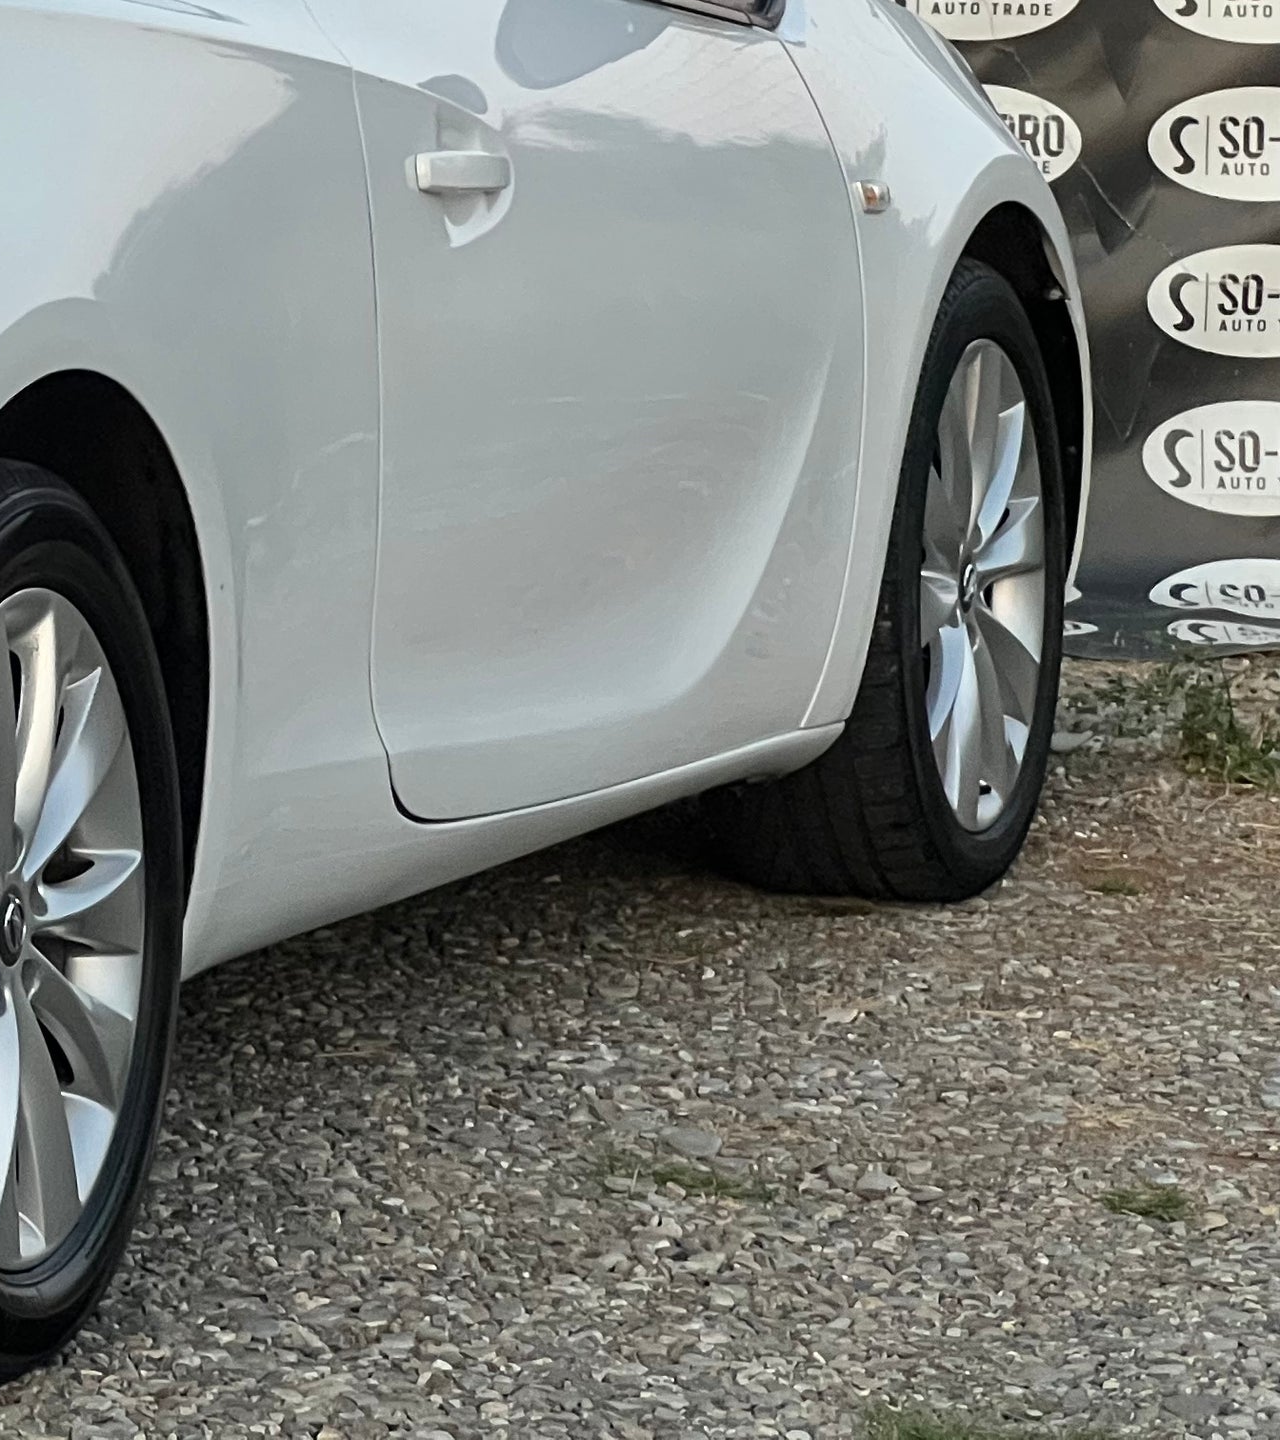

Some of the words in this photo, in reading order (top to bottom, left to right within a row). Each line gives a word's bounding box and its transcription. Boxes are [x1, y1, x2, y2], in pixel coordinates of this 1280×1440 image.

[932, 2, 979, 15] AUTO
[992, 3, 1052, 16] TRADE
[1224, 5, 1272, 17] AUTO
[1221, 163, 1269, 176] AUTO
[1219, 319, 1266, 331] AUTO
[1217, 476, 1265, 490] AUTO
